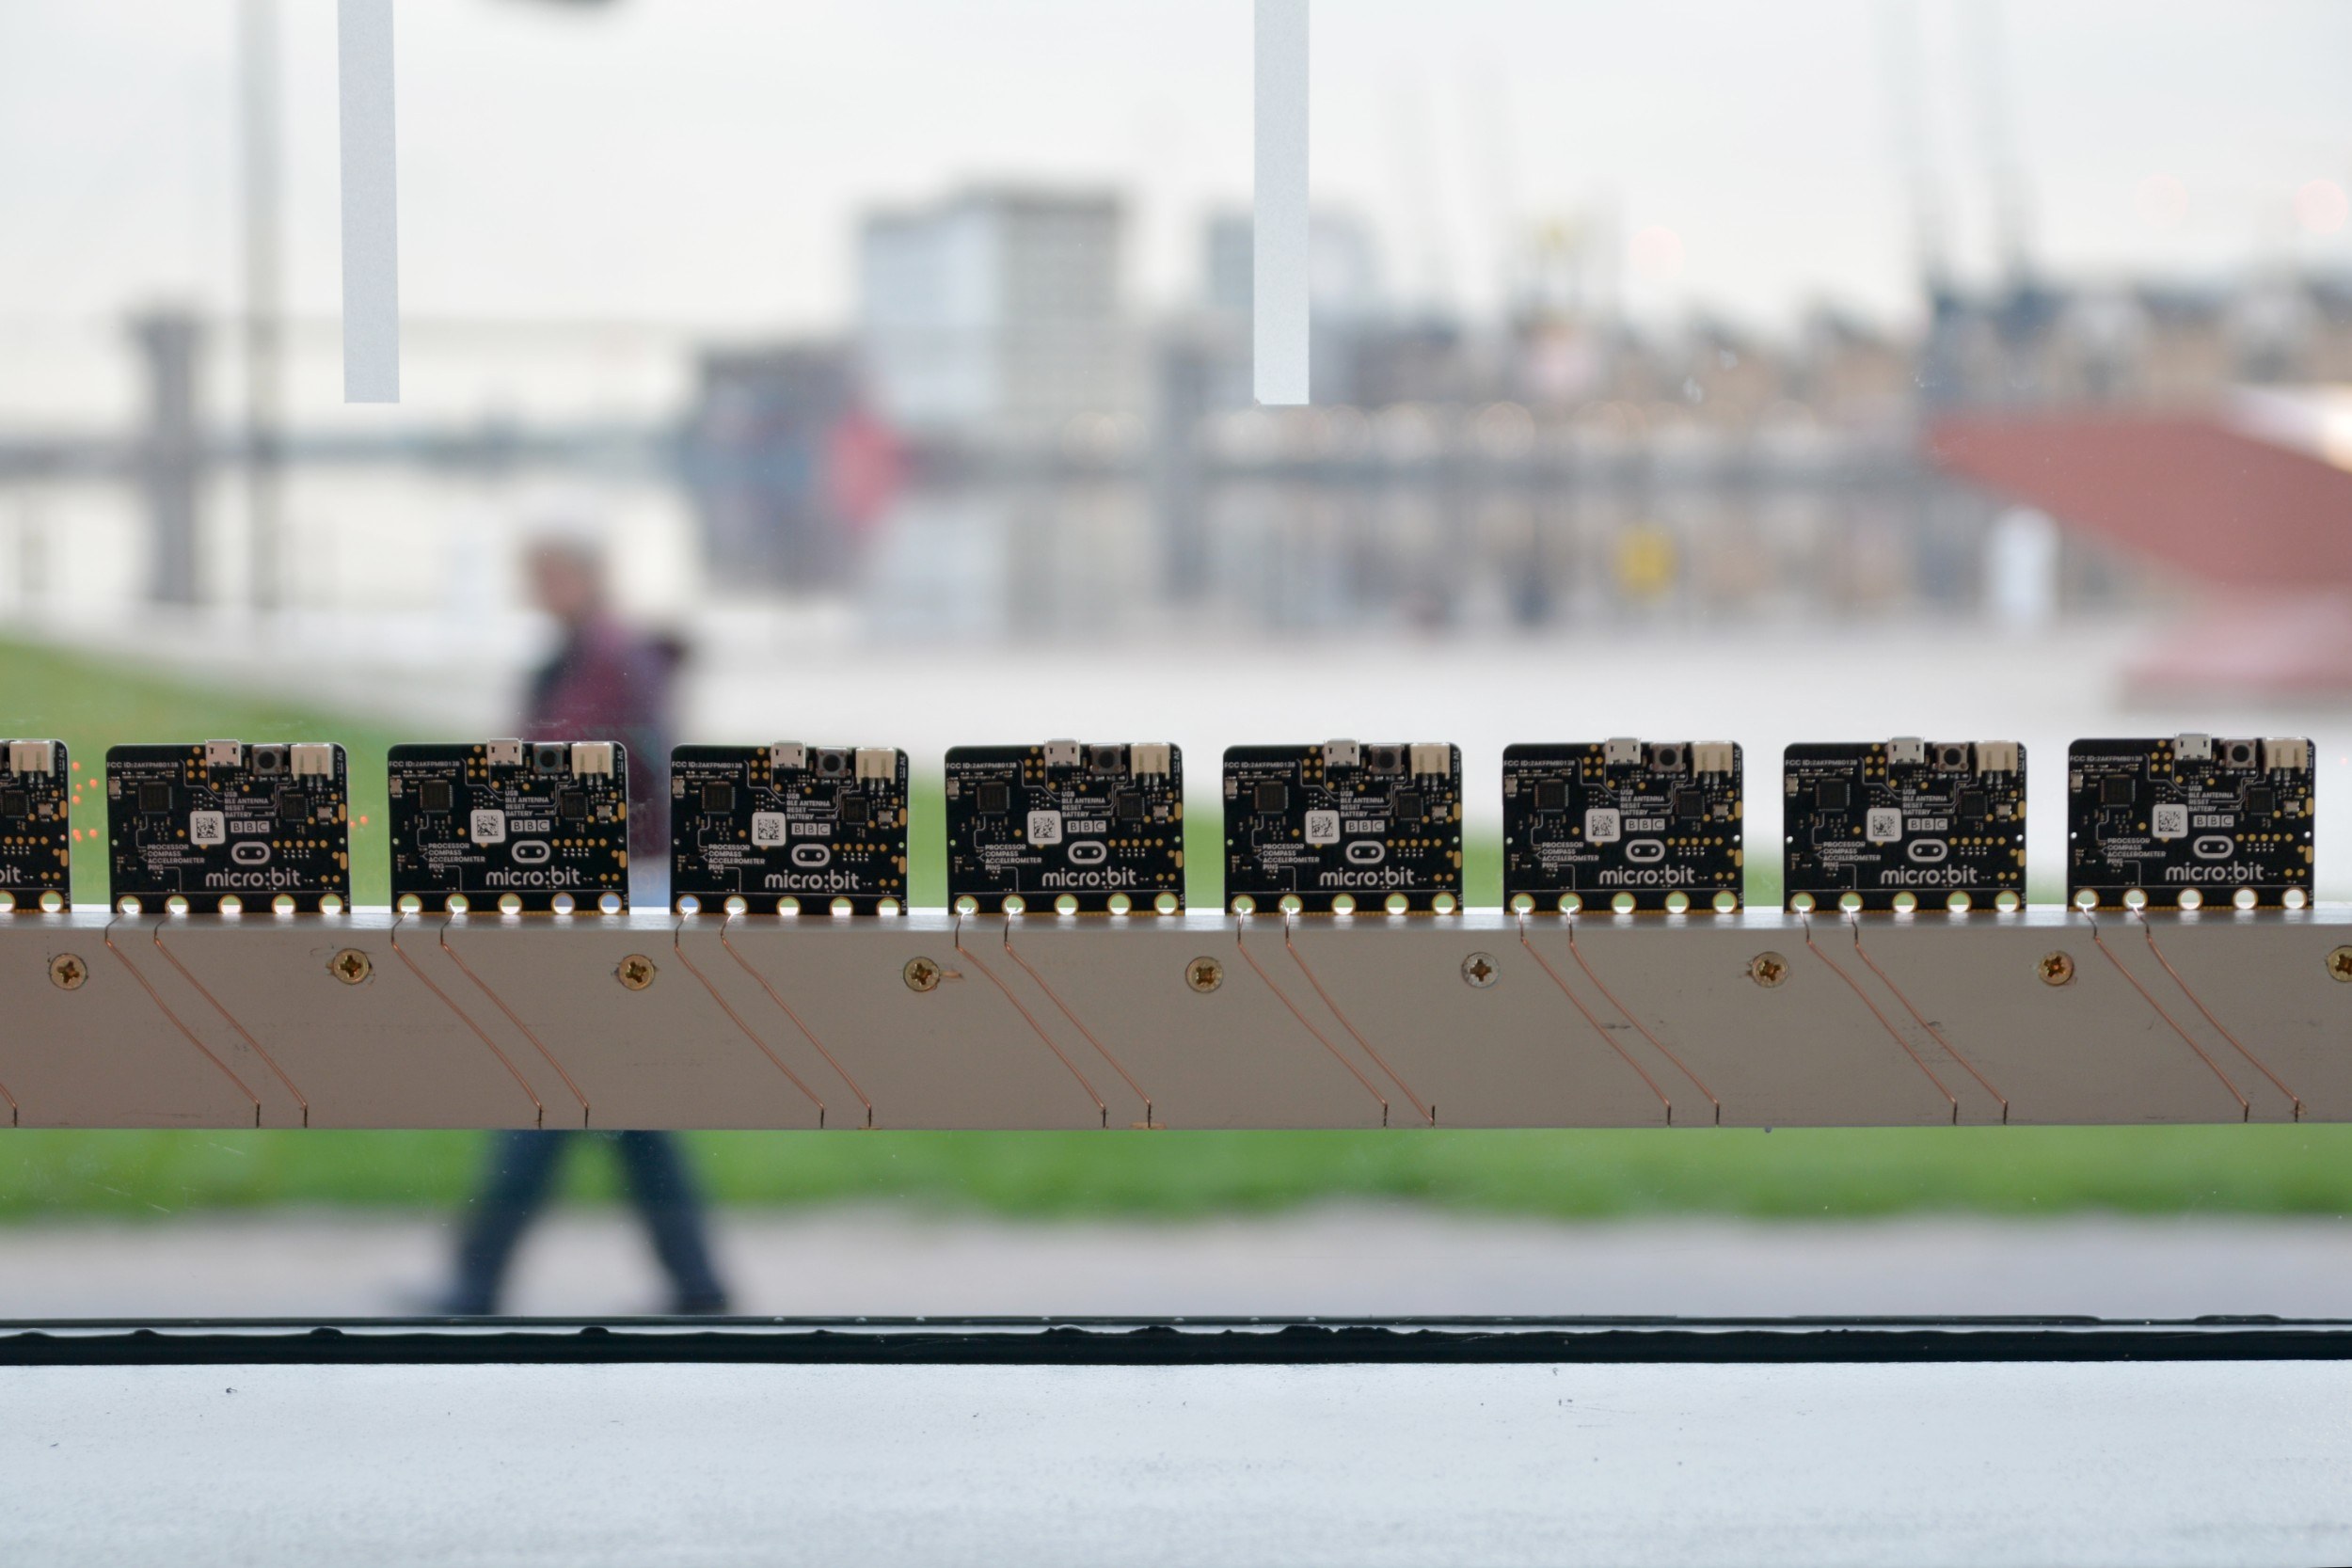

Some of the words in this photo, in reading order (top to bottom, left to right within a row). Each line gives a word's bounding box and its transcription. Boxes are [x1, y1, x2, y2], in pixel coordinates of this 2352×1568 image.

[230, 821, 269, 833] BBC
[511, 820, 550, 832] BBC
[1067, 820, 1106, 833] BBC
[1346, 820, 1385, 832] BBC
[1626, 819, 1665, 831] BBC
[1908, 818, 1948, 830] BBC
[2194, 815, 2235, 827] BBC
[791, 823, 831, 836] BBC
[205, 867, 300, 887] micro:bit
[486, 866, 580, 886] micro:bit
[1042, 866, 1136, 887] micro:bit
[1319, 866, 1414, 886] micro:bit
[1599, 865, 1695, 884] micro:bit
[1880, 865, 1977, 884] micro:bit
[2165, 861, 2264, 881] micro:bit
[765, 869, 859, 890] micro:bit
